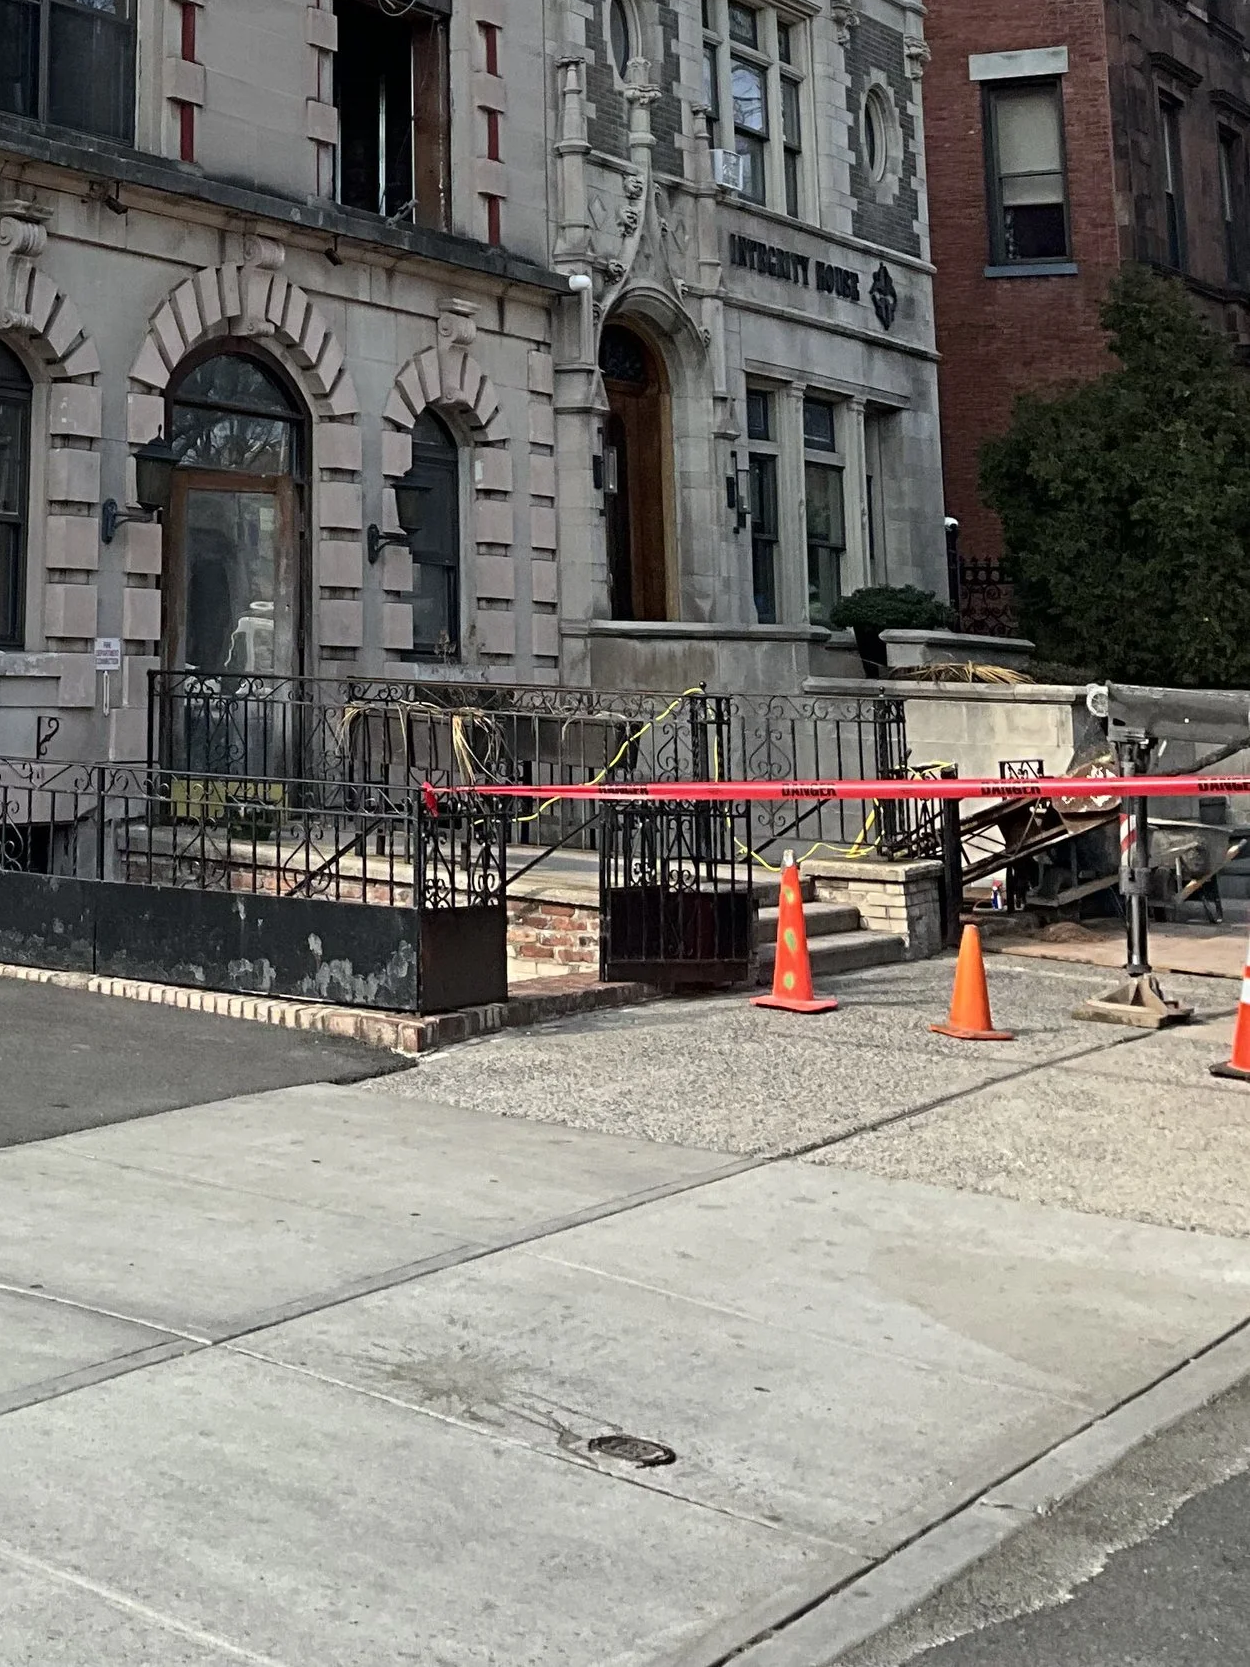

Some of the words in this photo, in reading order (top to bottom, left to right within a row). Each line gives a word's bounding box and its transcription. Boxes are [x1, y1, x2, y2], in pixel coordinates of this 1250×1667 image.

[730, 233, 810, 286] INTEGRITY
[815, 260, 861, 302] HOUSE
[781, 782, 837, 797] DANGER
[980, 780, 1041, 796] DANGER
[1197, 777, 1250, 792] DANGE
